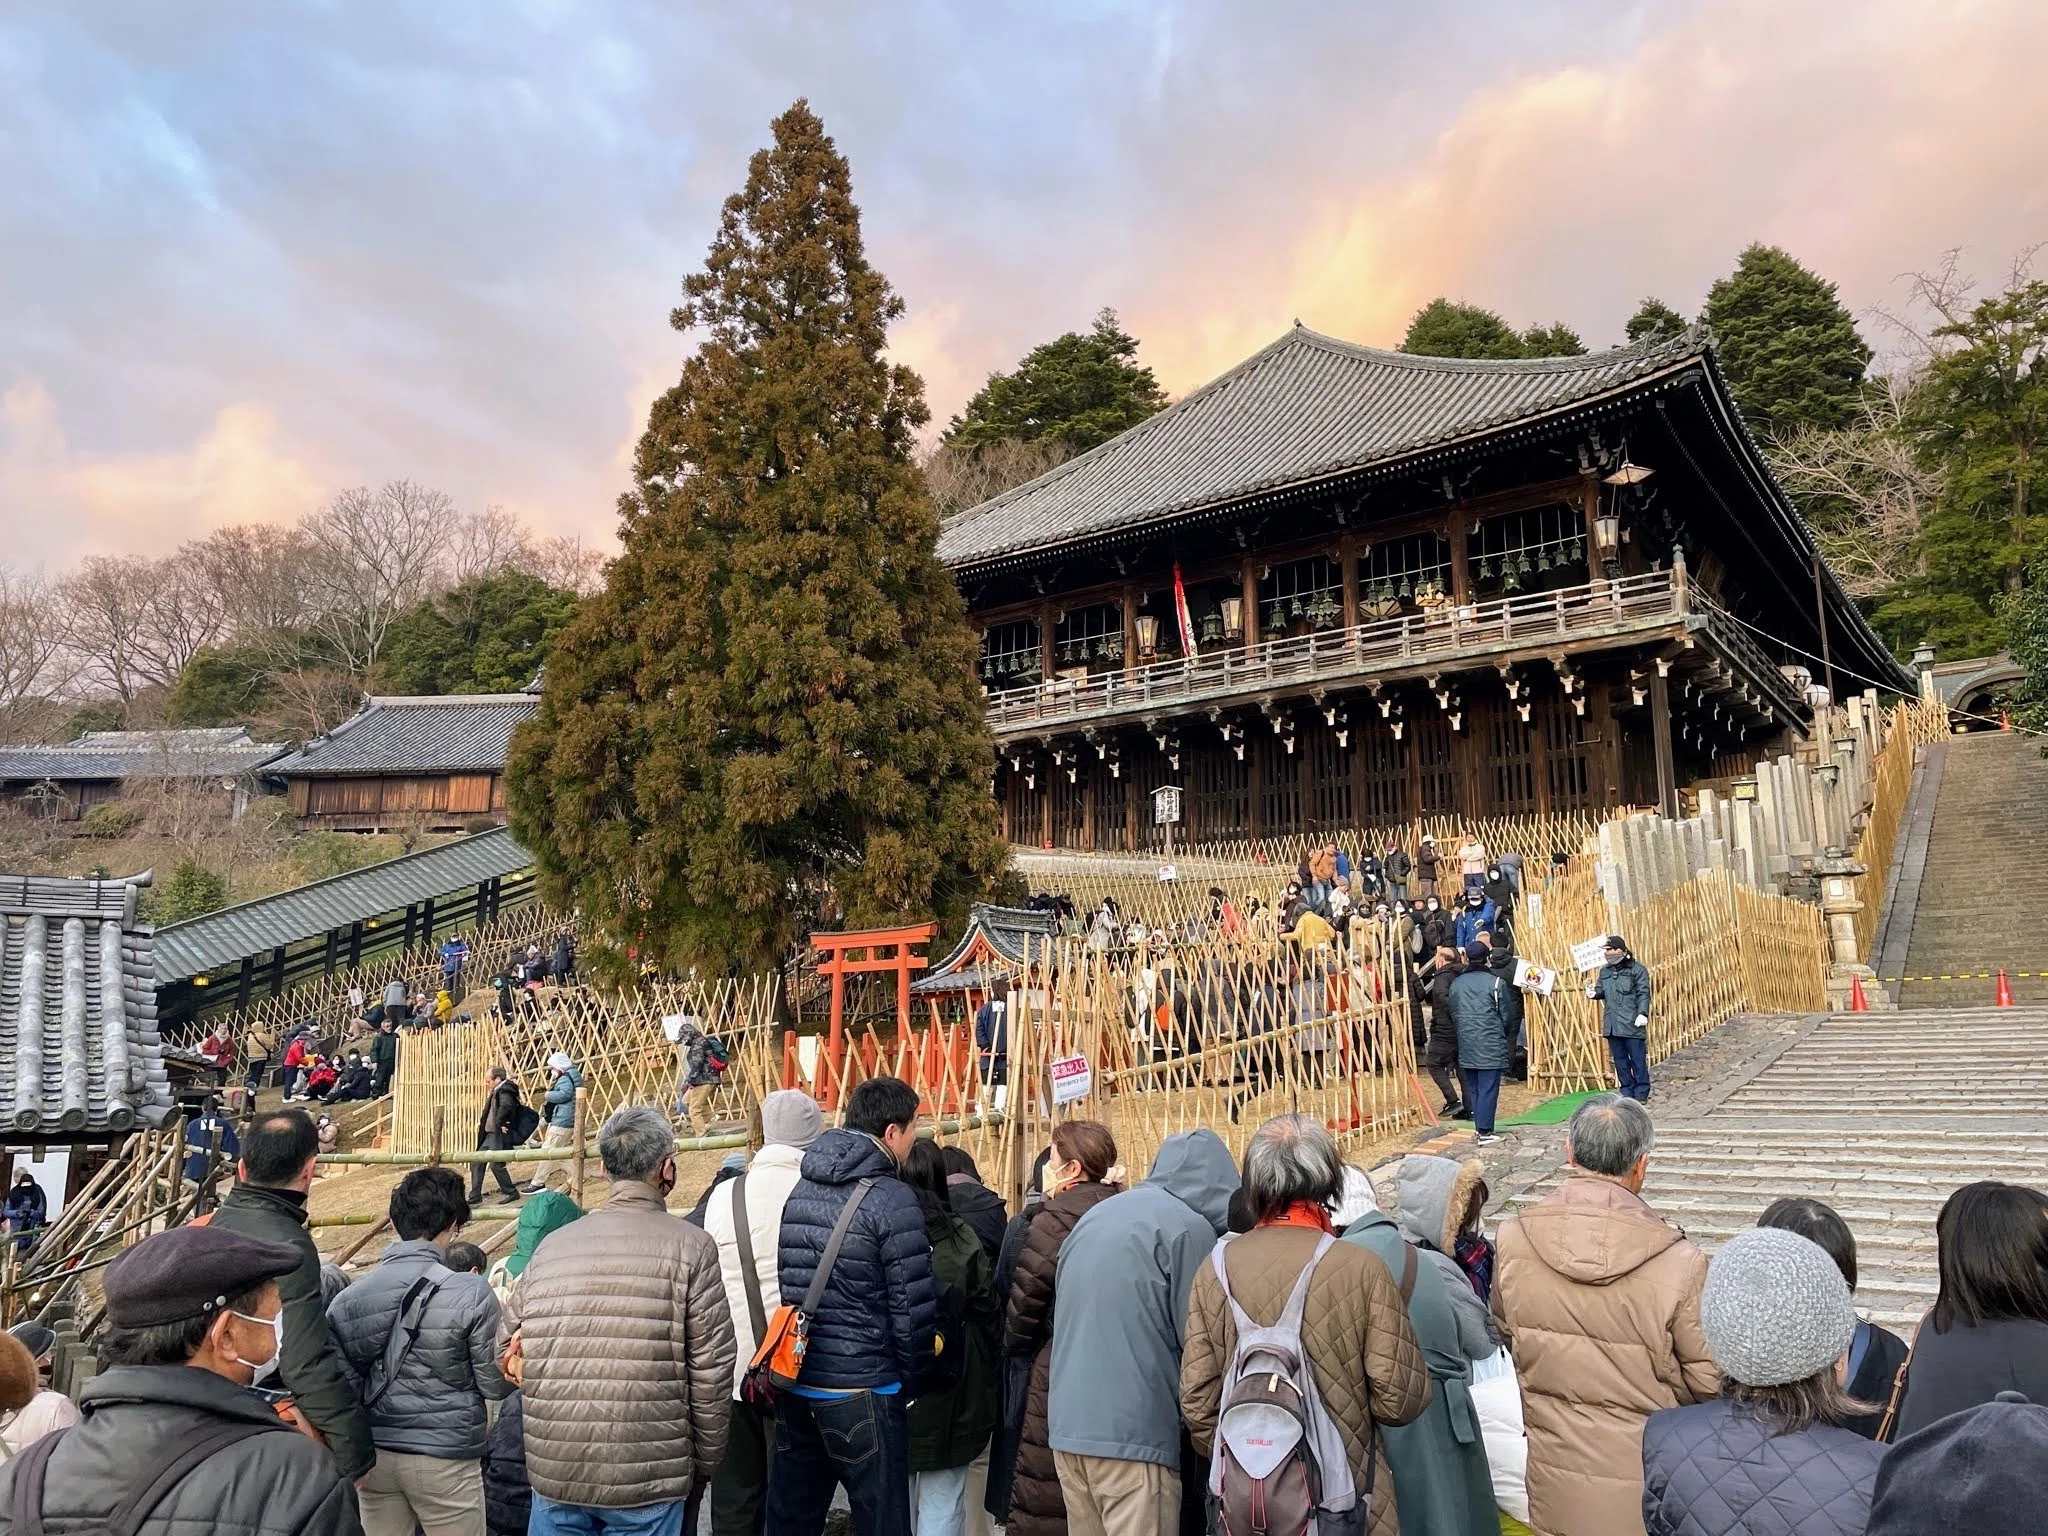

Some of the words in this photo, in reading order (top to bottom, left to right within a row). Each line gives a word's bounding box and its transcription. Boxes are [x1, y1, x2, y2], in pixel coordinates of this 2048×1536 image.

[1053, 1060, 1086, 1079] 緊急出入口
[1056, 1078, 1079, 1088] Emergency
